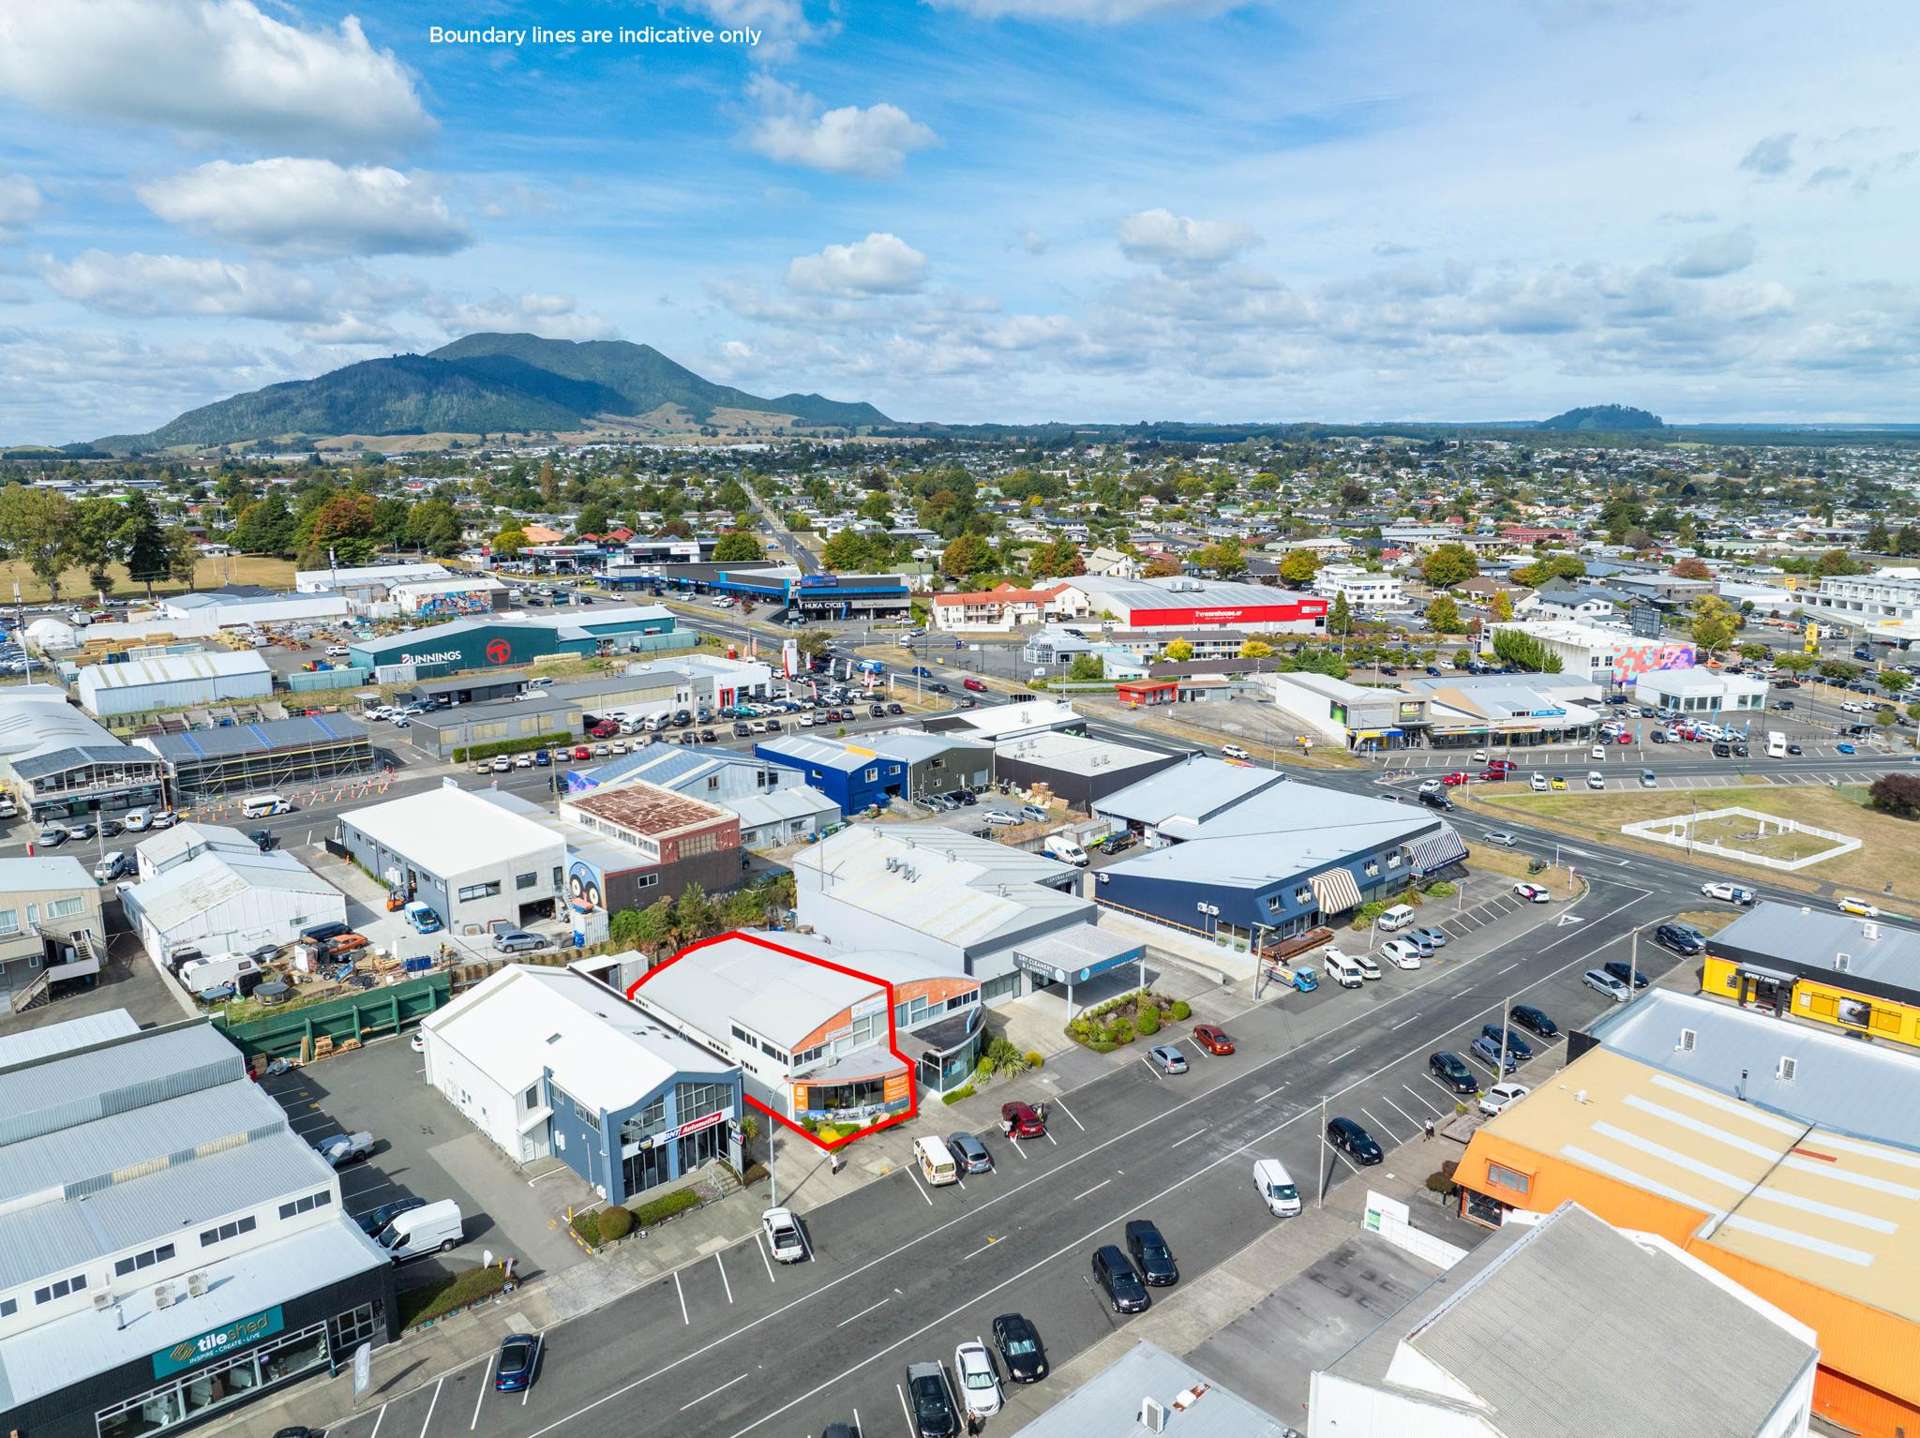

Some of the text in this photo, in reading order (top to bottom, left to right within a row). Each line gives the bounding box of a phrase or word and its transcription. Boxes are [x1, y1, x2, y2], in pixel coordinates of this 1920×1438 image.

[400, 650, 462, 665] BUNNINGS
[1744, 971, 1760, 980] OPEN
[1764, 977, 1781, 985] DAYS
[663, 1114, 721, 1142] BNT Automotive
[189, 1331, 261, 1364] INSPIRE CREATE LIVE
